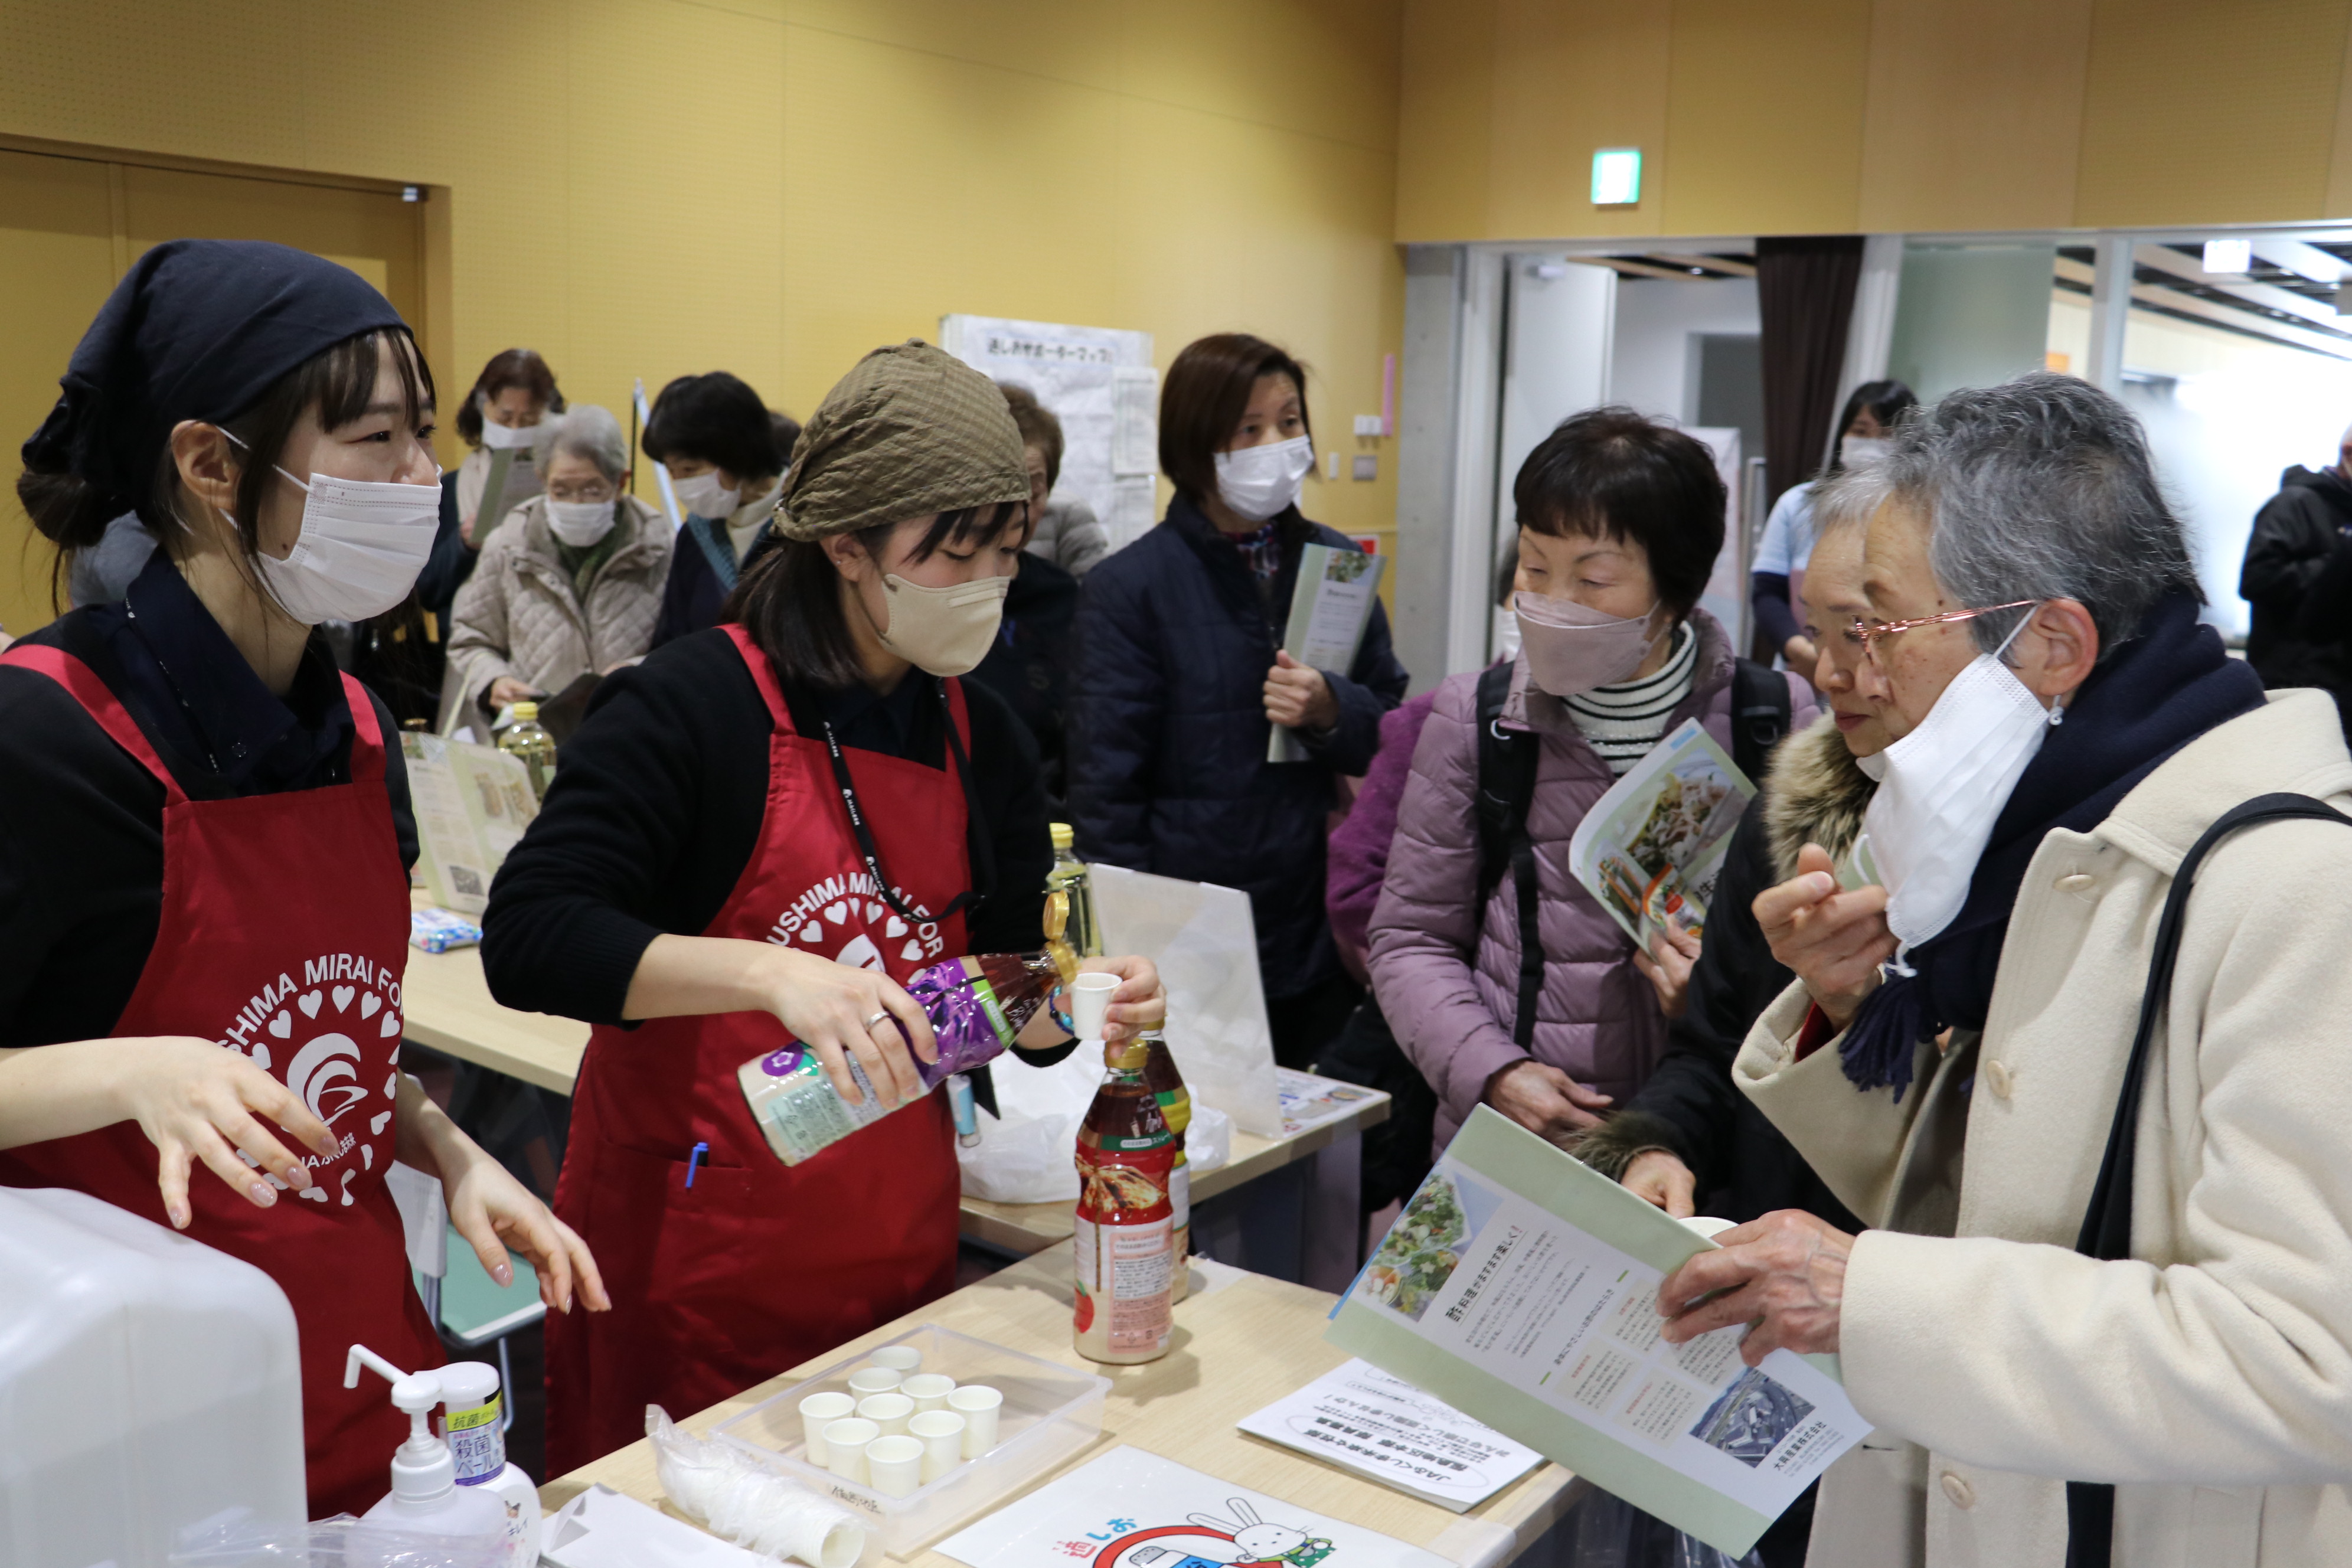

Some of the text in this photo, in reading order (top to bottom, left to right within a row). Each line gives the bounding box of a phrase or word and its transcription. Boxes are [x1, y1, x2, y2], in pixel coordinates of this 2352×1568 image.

[305, 953, 374, 986] MIRAI
[378, 966, 404, 1017] FO
[454, 1434, 491, 1459] 殺菌
[457, 1454, 496, 1475] ベール
